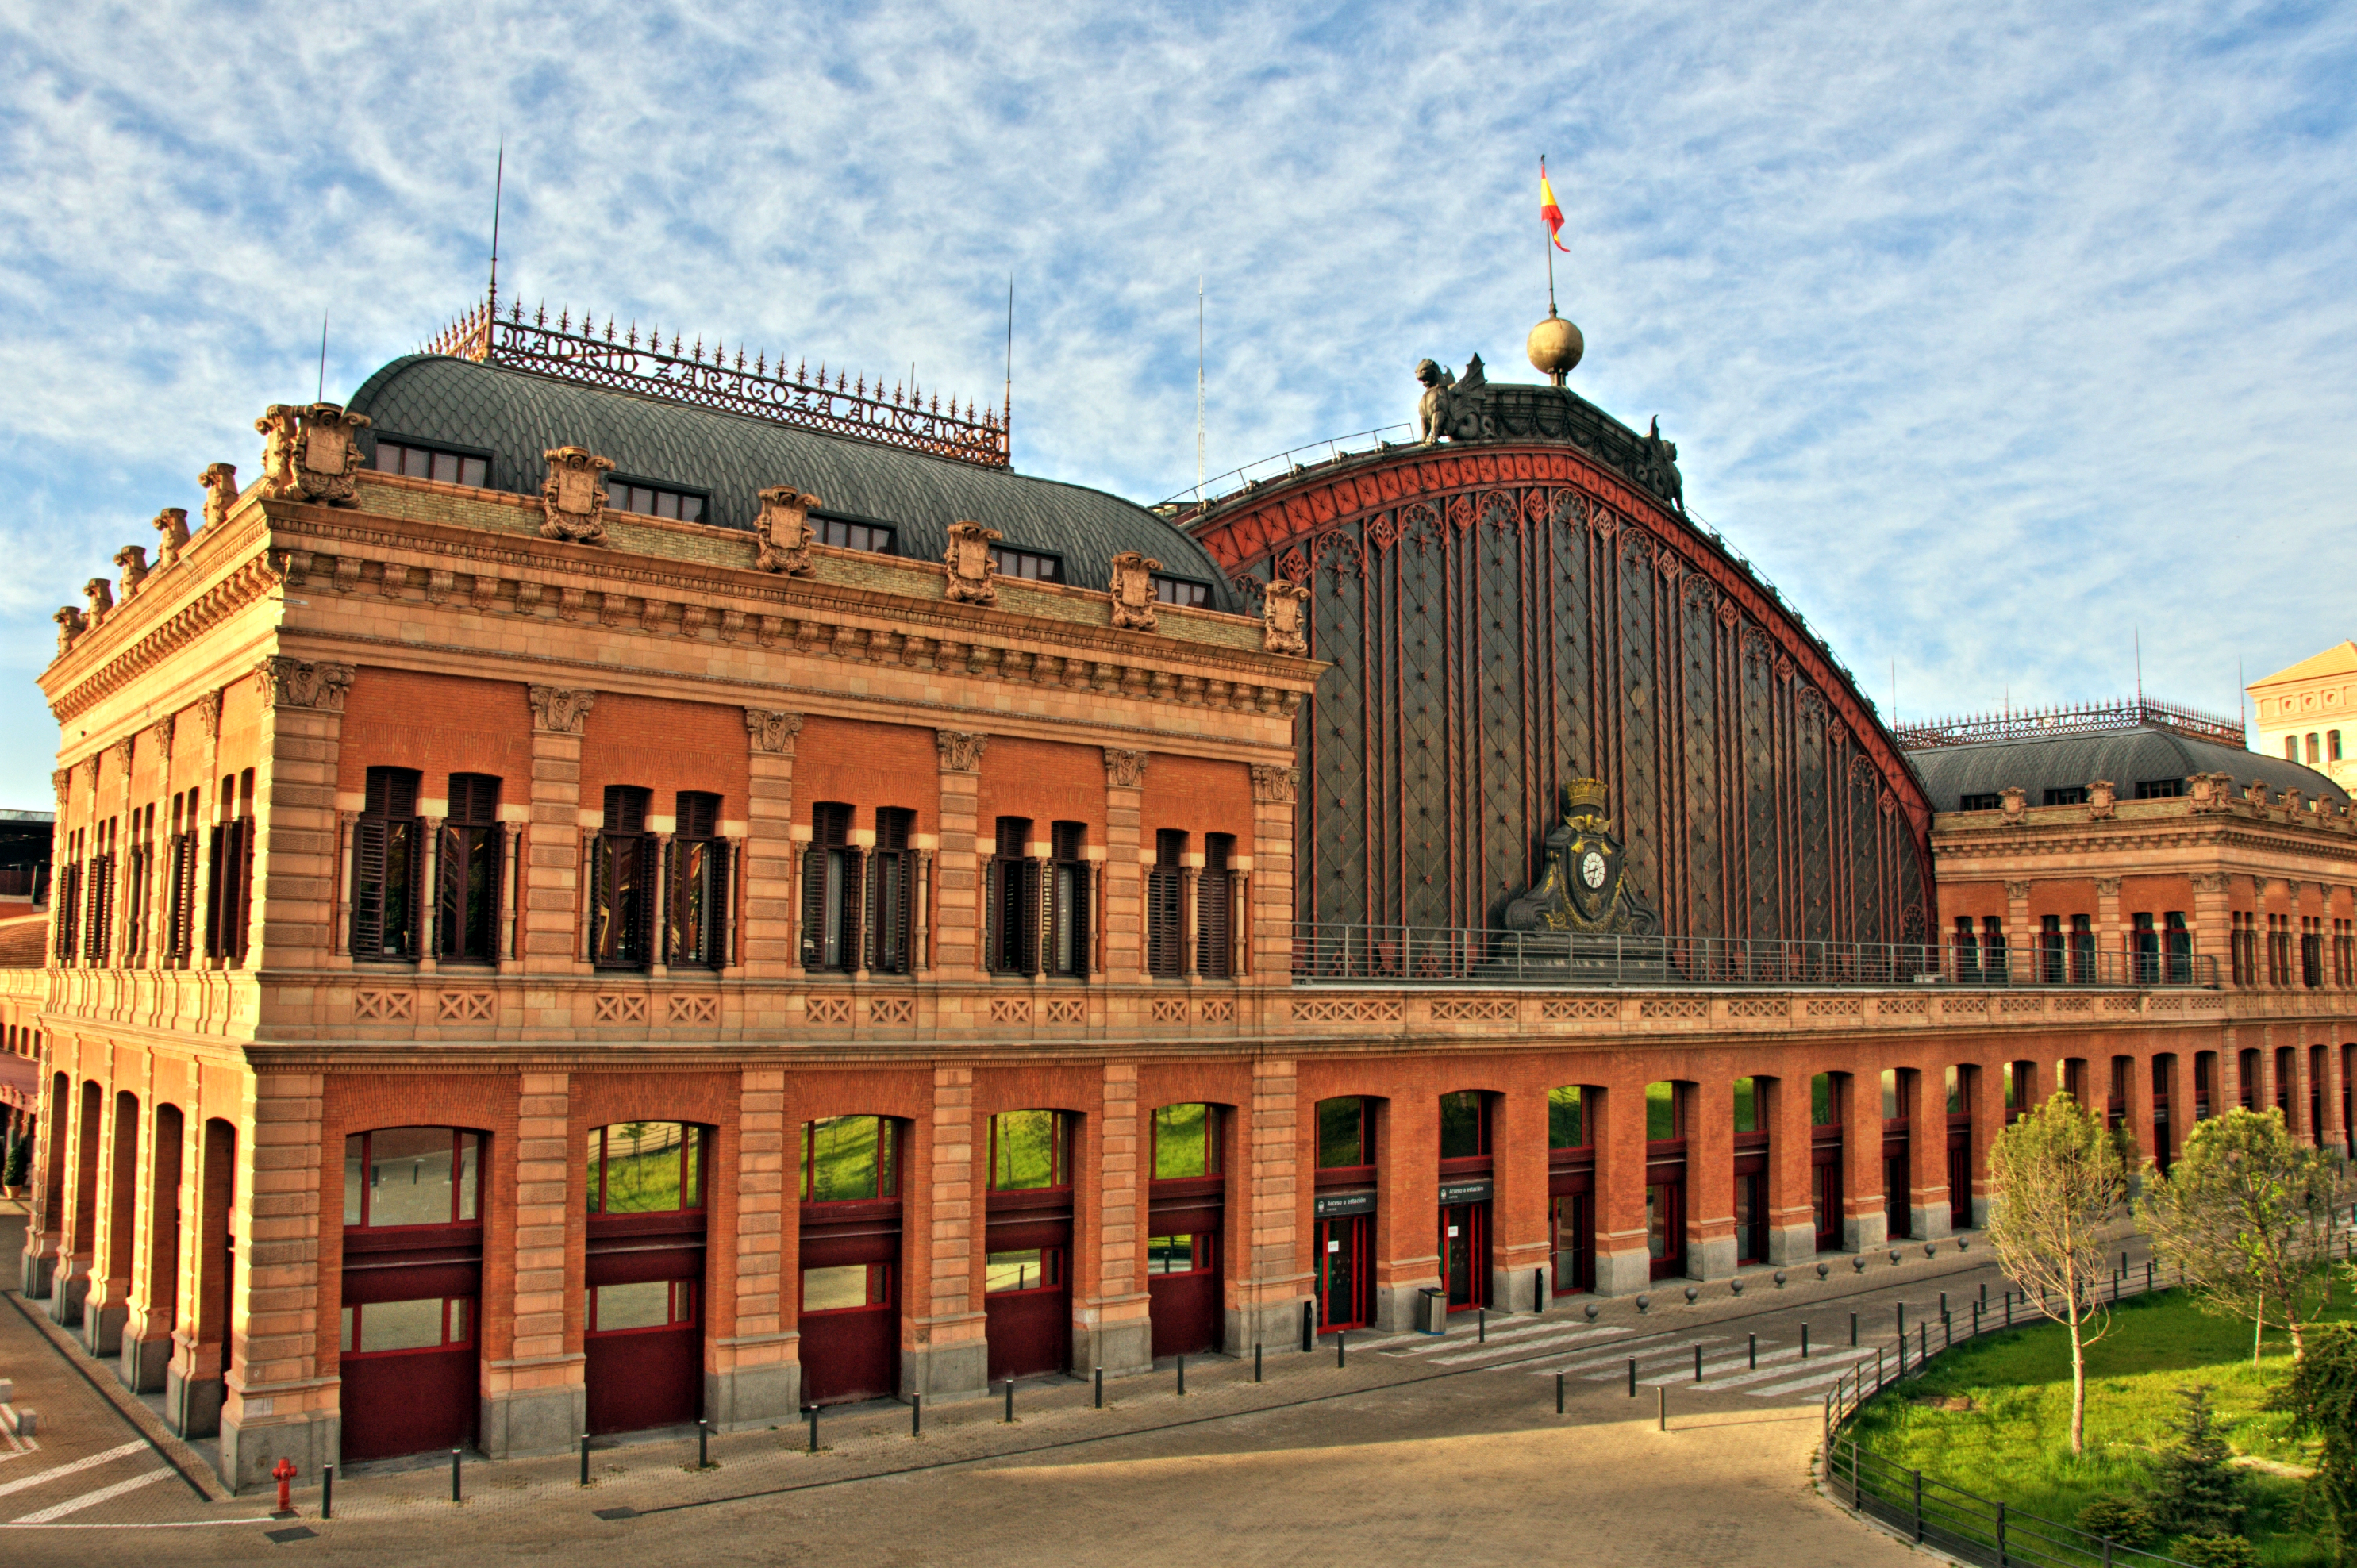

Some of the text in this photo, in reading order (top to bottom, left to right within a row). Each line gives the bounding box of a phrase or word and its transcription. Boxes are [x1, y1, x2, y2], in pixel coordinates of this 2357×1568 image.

[502, 326, 639, 374] MADRID
[654, 357, 833, 416] ZARAGOZA
[845, 399, 997, 452] ALICANTE
